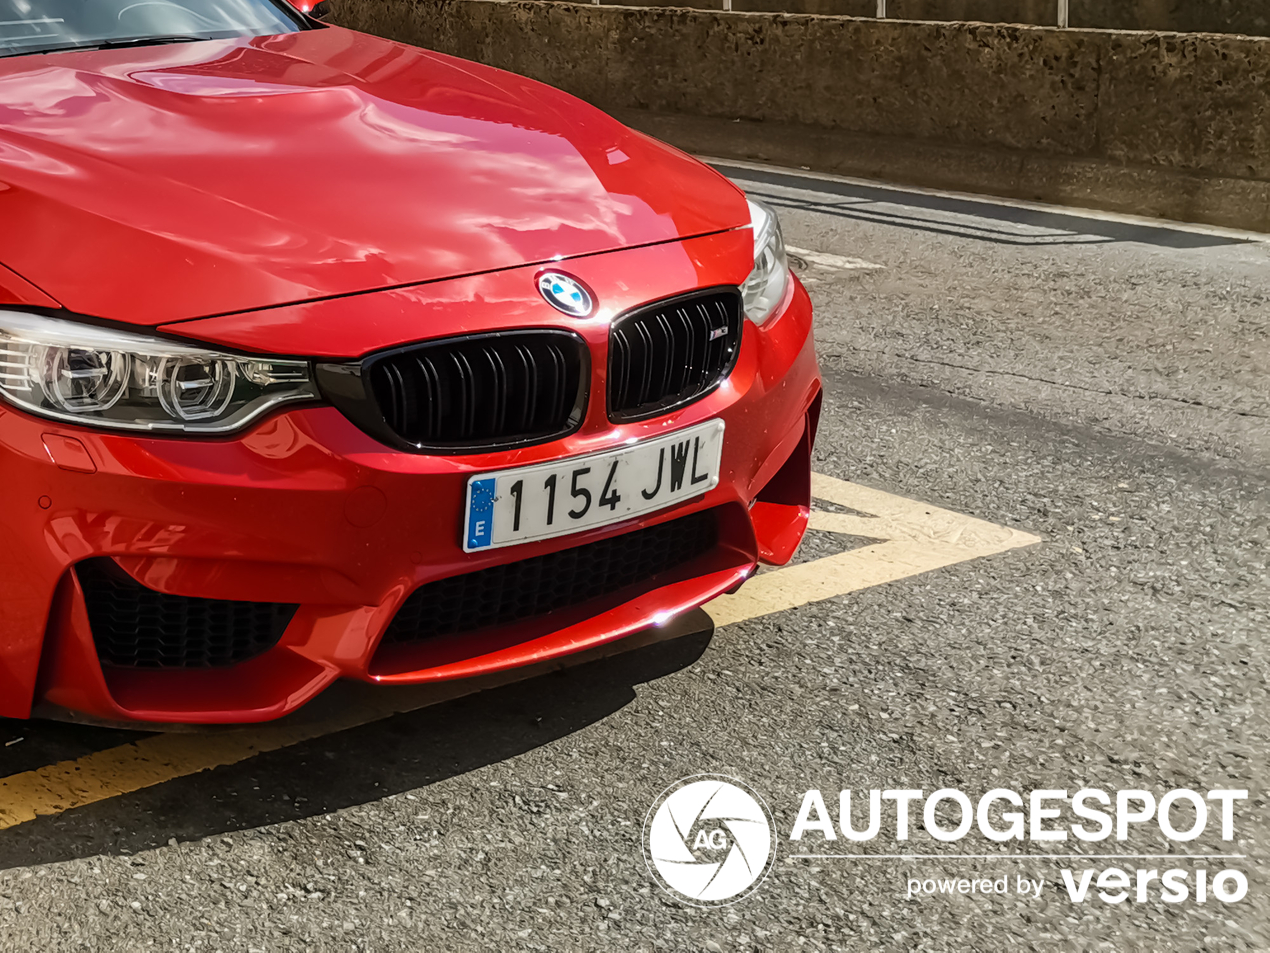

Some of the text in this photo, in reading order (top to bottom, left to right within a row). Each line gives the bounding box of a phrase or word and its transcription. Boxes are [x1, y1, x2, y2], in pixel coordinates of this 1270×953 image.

[510, 436, 709, 532] 1154 JWL
[475, 520, 486, 537] E
